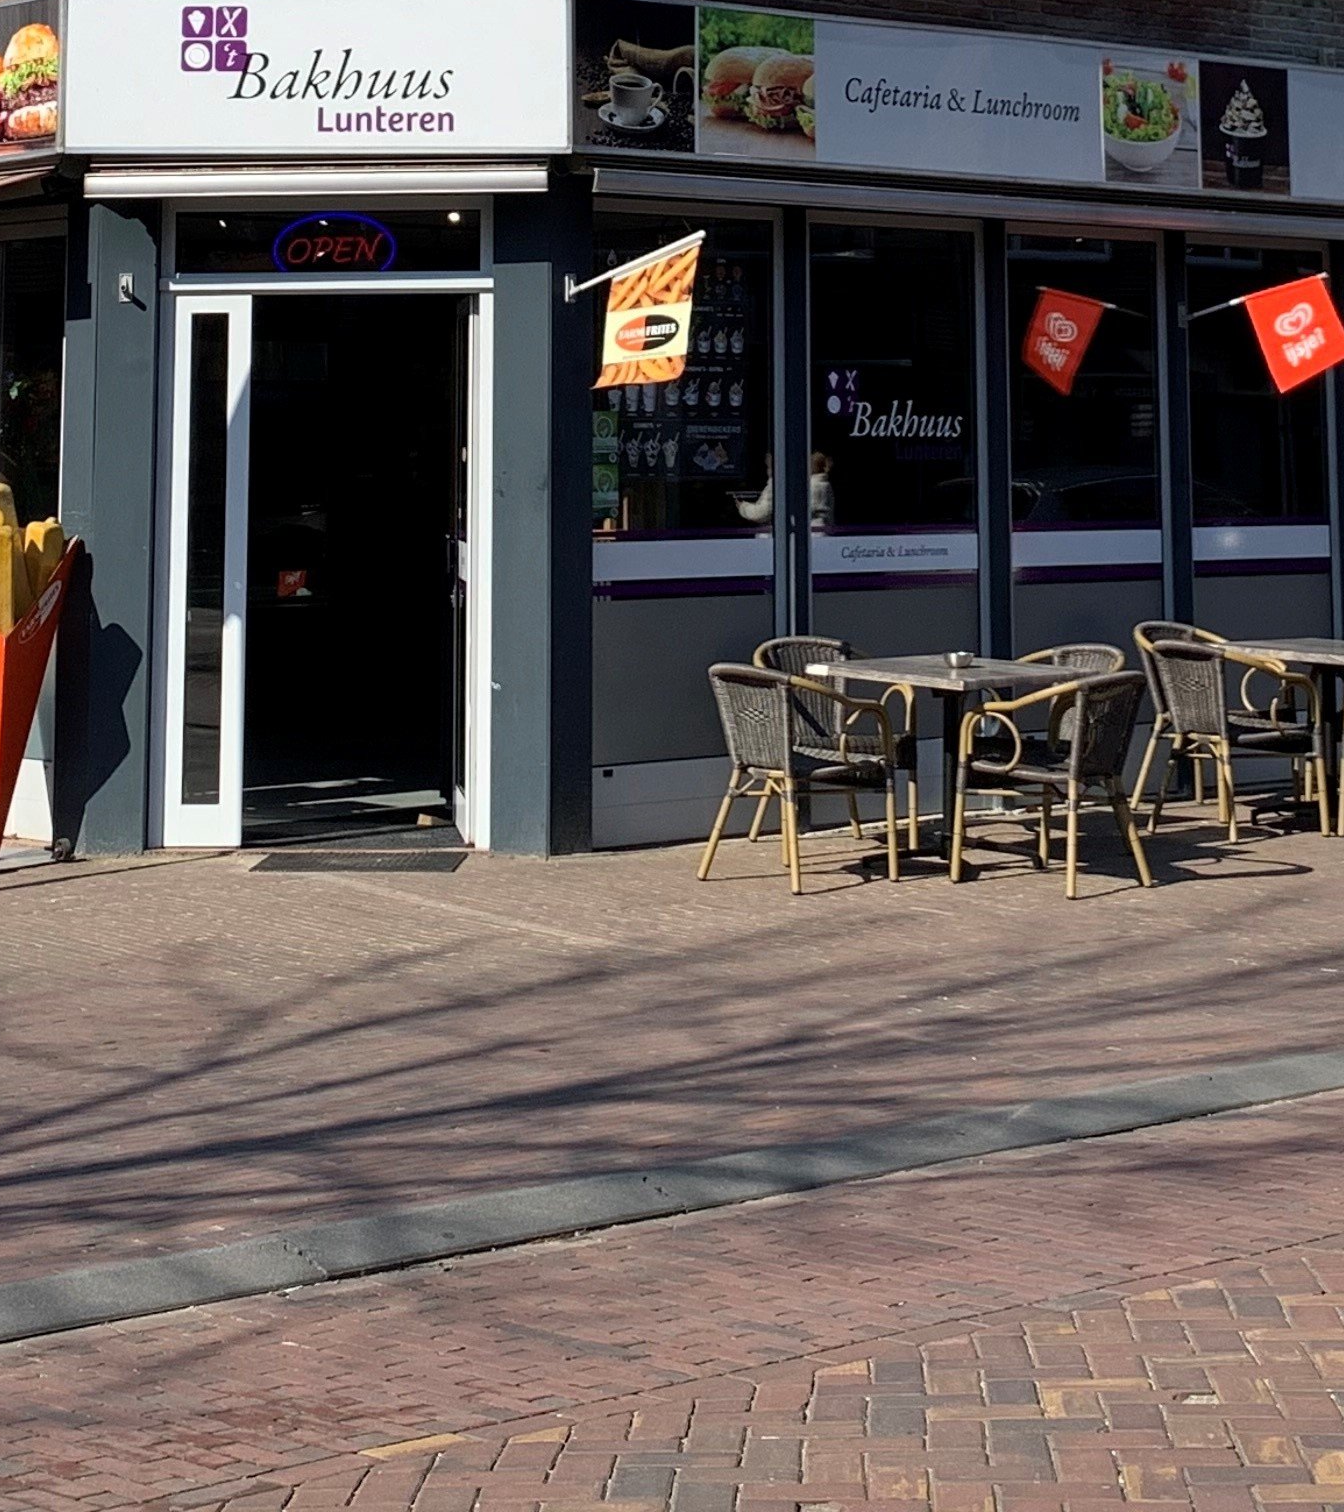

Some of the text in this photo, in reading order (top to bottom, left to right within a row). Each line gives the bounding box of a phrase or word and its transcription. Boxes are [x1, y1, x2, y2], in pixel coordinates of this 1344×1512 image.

[227, 48, 454, 100] Bakhuus
[317, 105, 454, 133] Lunteren
[844, 78, 1081, 122] Cafetaria & Lunchroom
[287, 233, 384, 264] OPEN
[848, 399, 964, 438] Bakhuus
